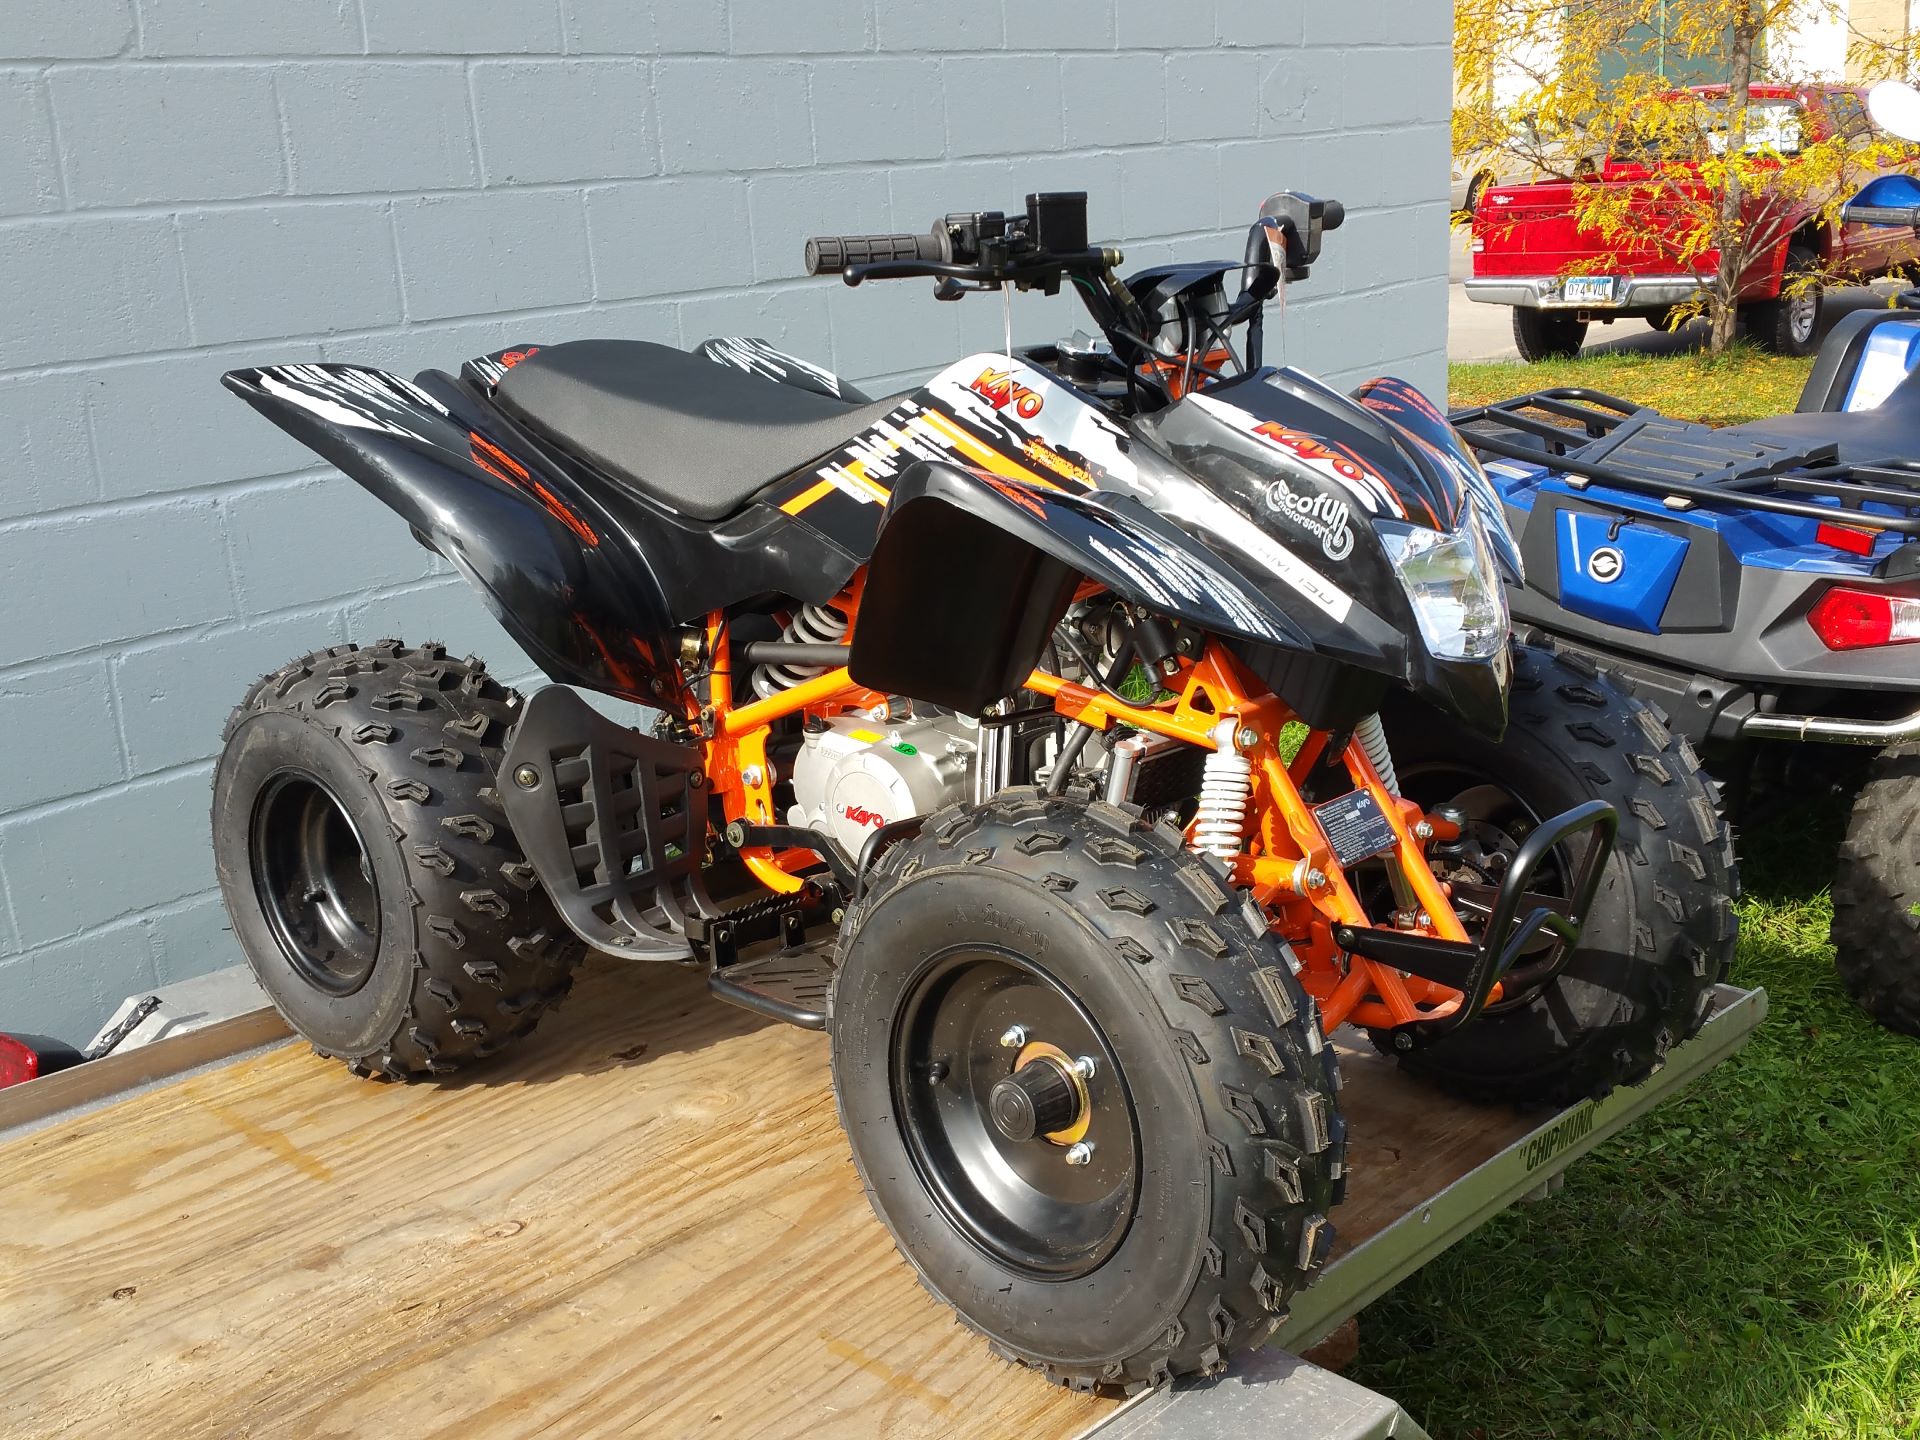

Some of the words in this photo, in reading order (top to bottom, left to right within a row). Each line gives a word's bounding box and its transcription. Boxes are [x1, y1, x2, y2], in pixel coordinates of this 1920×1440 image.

[969, 367, 1044, 419] KAYO
[1251, 420, 1365, 481] KAYO
[1278, 500, 1333, 549] motorsports
[846, 805, 884, 829] KAYO
